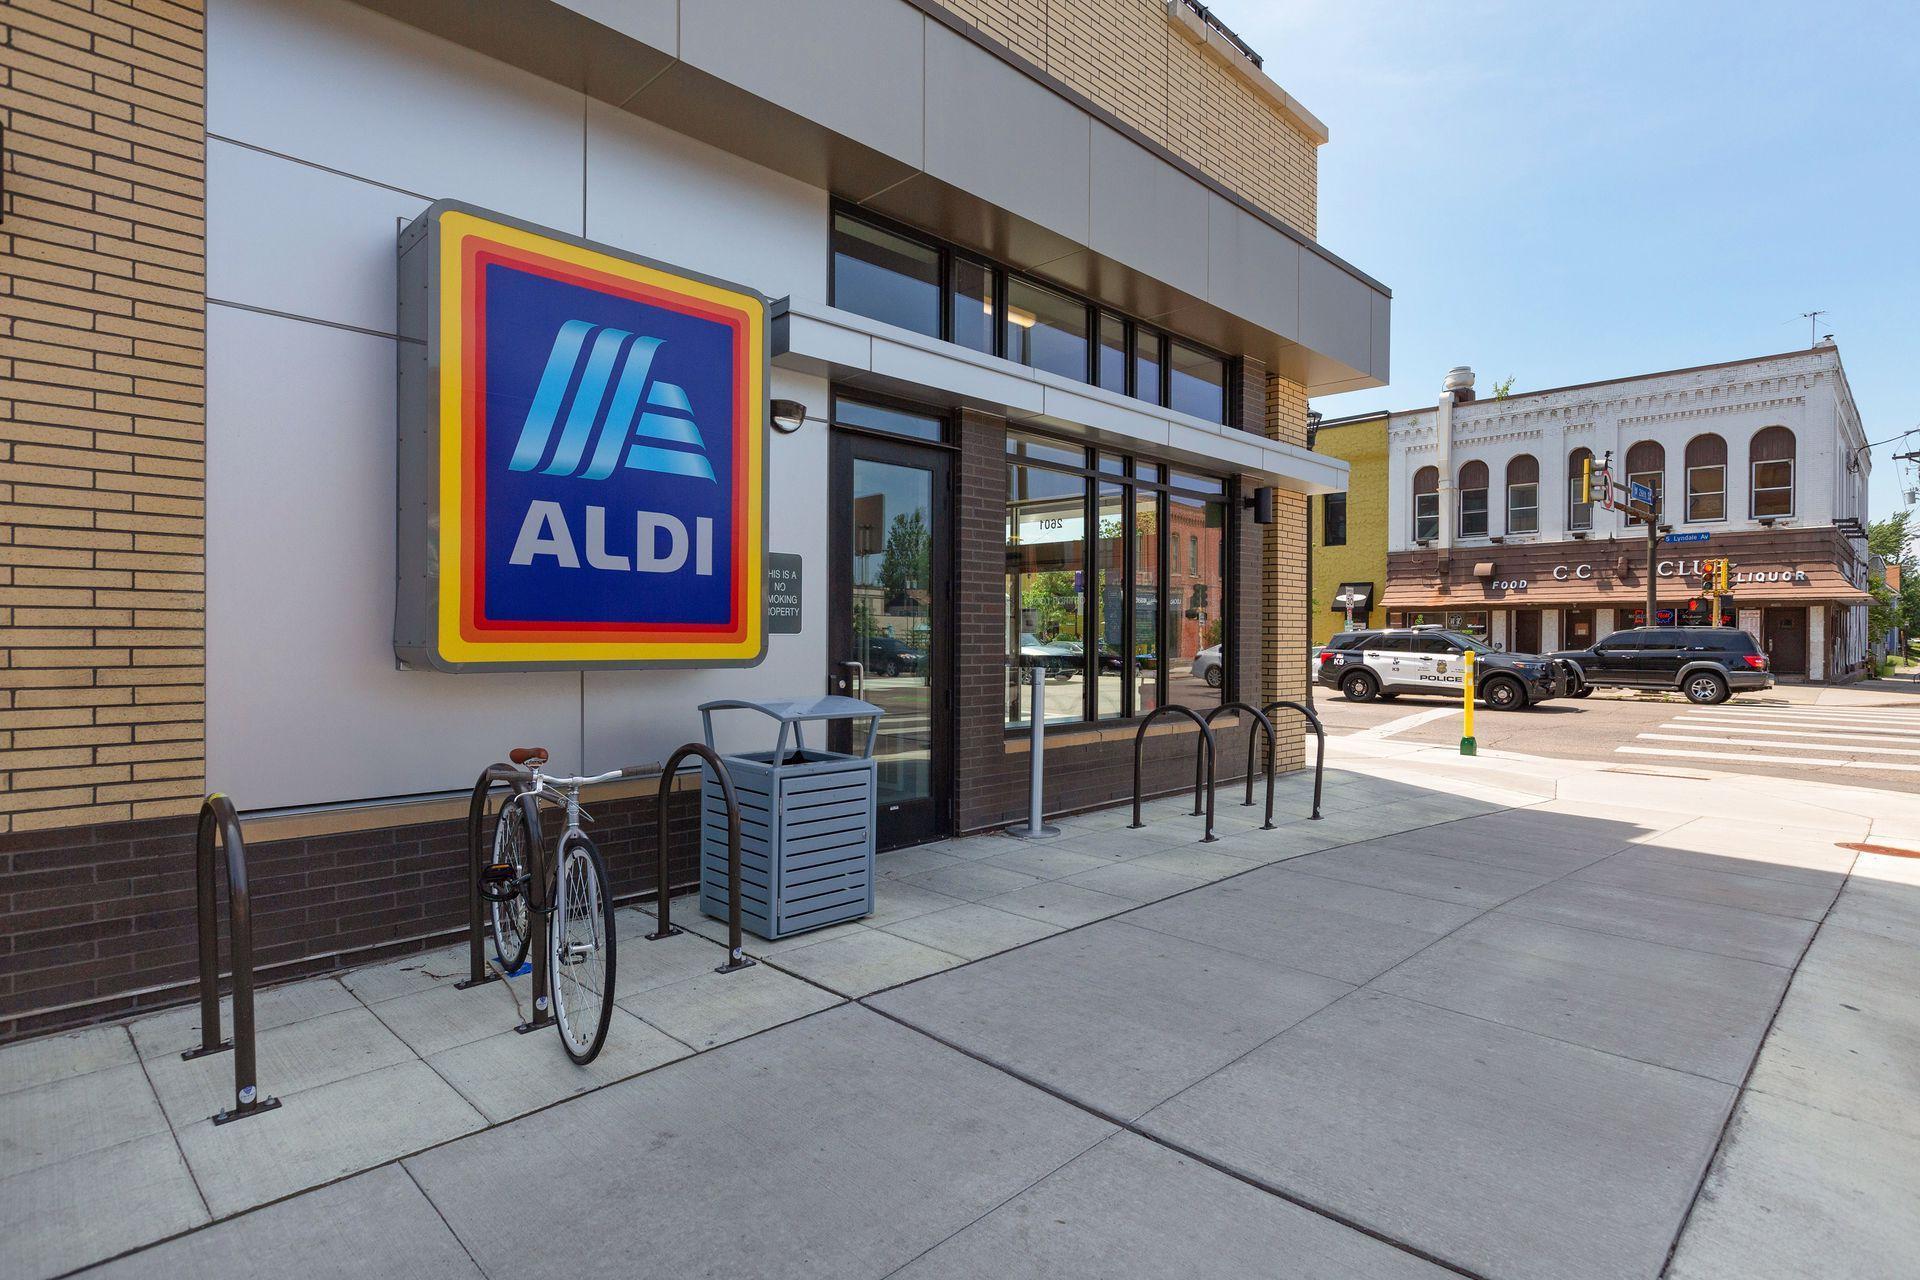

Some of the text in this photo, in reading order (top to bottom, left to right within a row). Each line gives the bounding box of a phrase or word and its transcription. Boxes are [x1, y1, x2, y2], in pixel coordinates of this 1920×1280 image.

[508, 499, 713, 576] ALDI
[768, 570, 797, 580] HIS IS A
[1737, 571, 1805, 582] LIQUOR
[775, 582, 786, 592] NO
[1492, 580, 1527, 590] FOOD
[768, 594, 798, 604] MOKING
[768, 606, 800, 616] OPERTY
[1333, 658, 1345, 666] K9
[1420, 674, 1463, 683] POLICE
